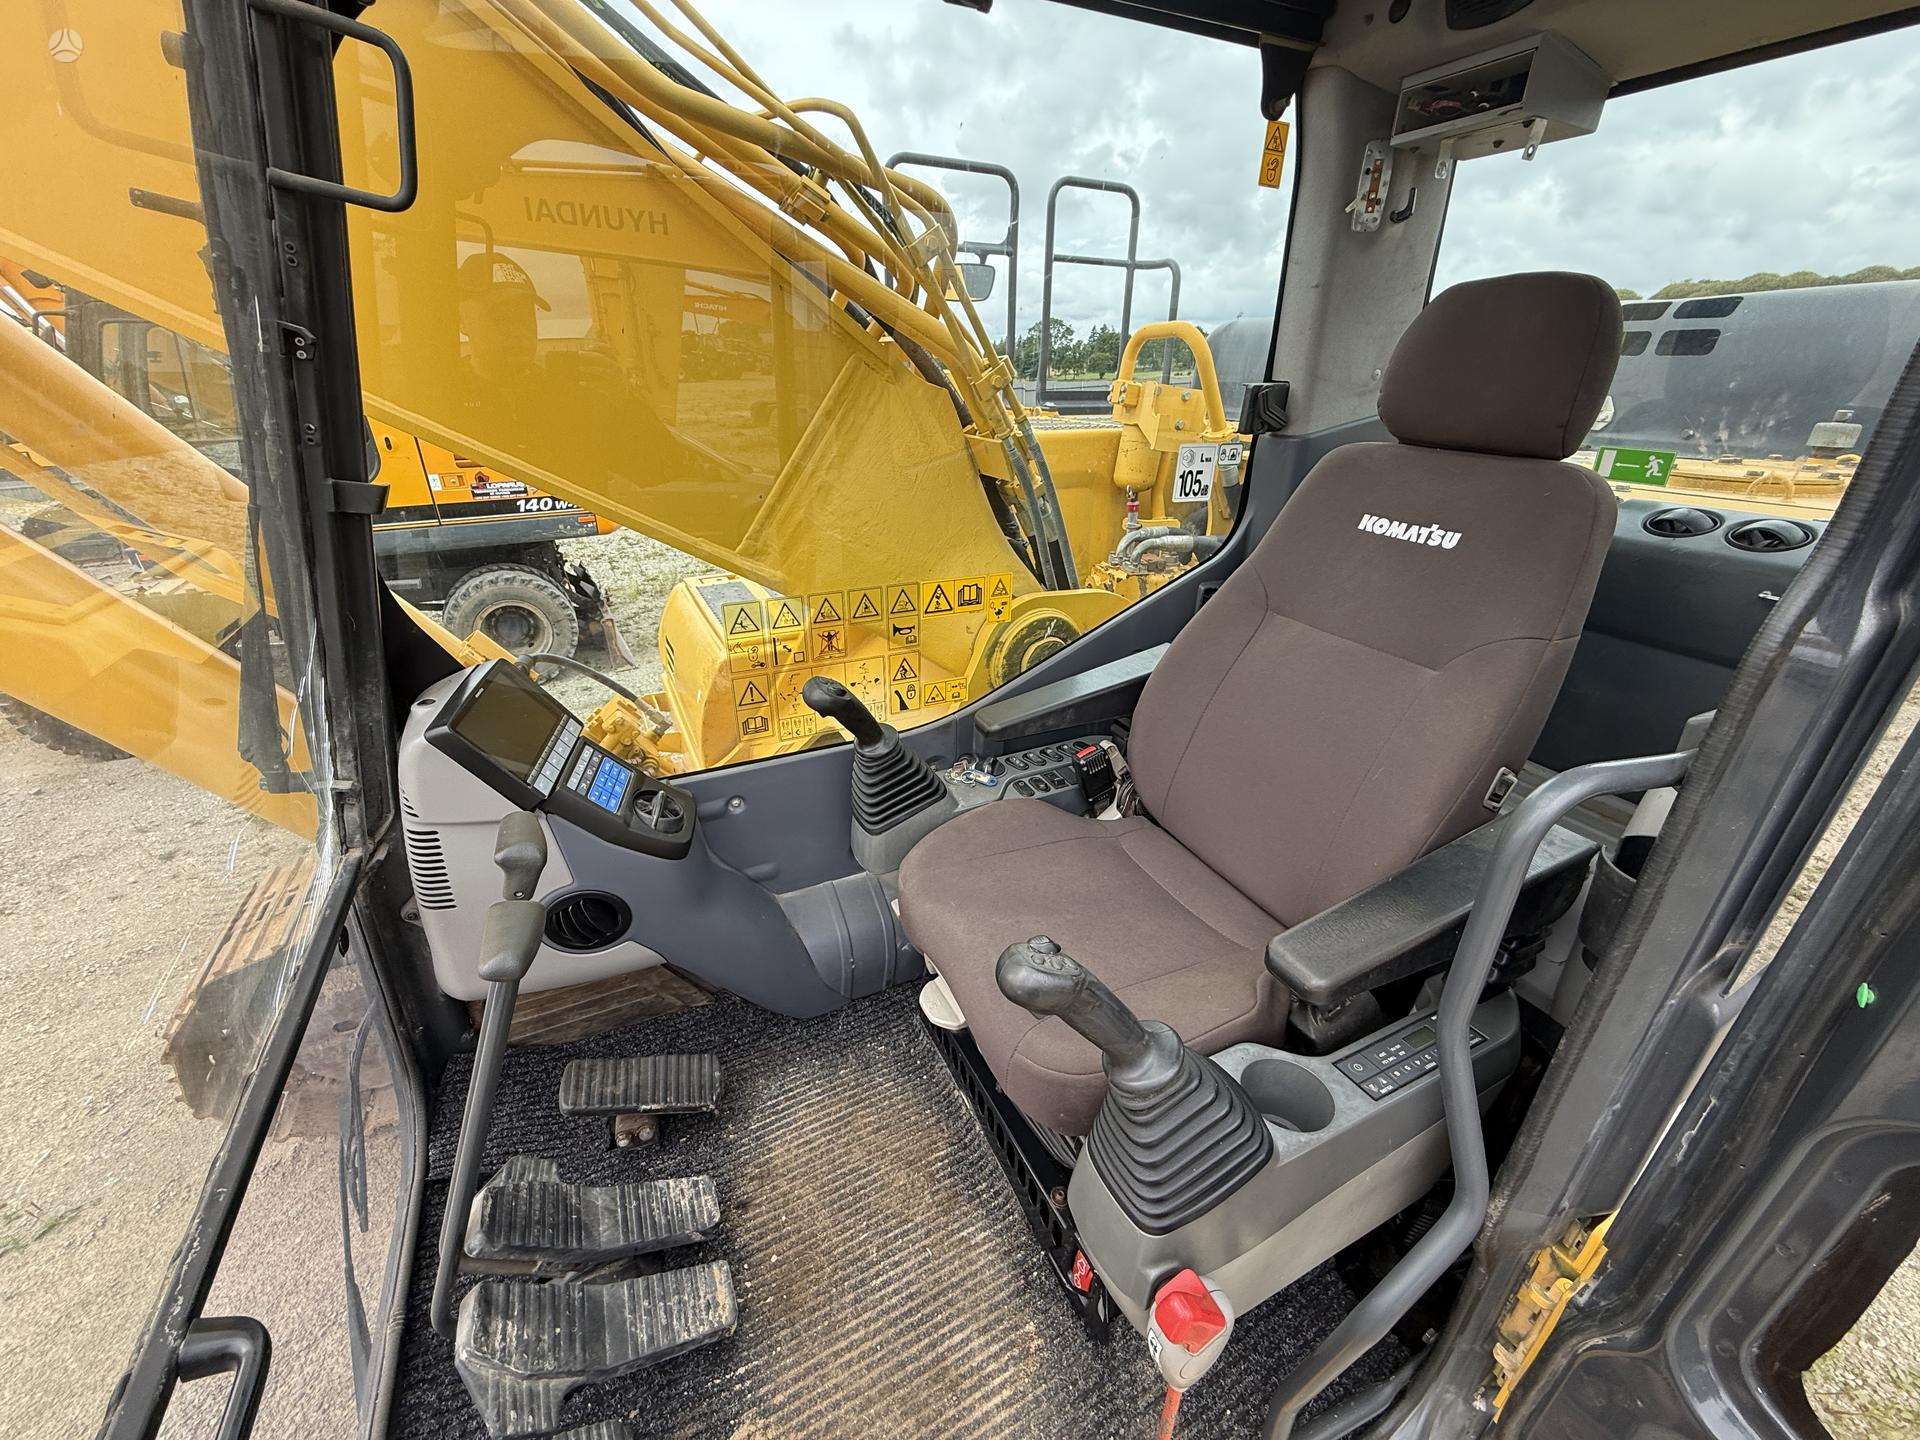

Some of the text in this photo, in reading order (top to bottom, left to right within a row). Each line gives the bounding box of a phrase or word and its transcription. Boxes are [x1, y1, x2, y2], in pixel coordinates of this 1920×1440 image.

[1179, 470, 1203, 497] 105
[517, 497, 553, 512] 140
[1357, 513, 1462, 549] KOMATSU
